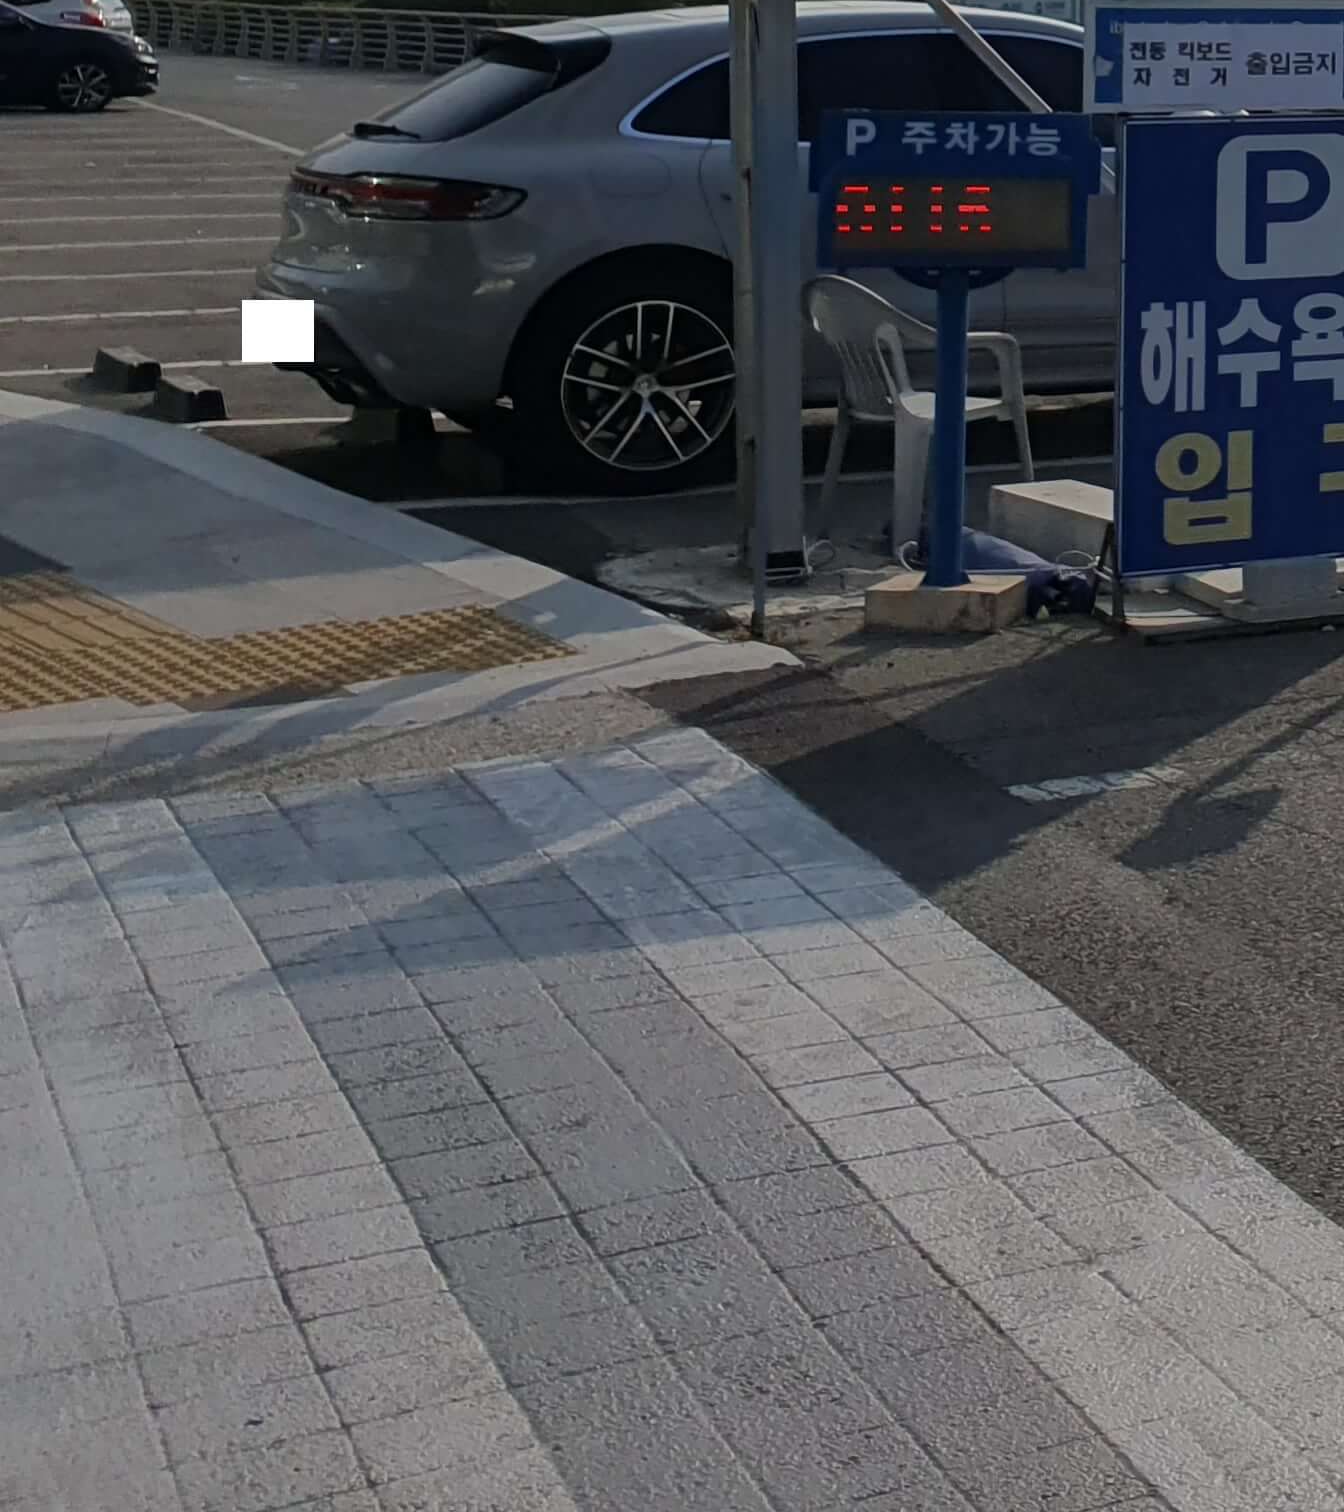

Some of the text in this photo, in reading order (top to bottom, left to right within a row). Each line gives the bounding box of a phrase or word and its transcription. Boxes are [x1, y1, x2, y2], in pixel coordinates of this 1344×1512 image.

[1129, 41, 1233, 61] 전동 킥보드
[1246, 51, 1337, 76] 출입금지
[846, 118, 1062, 157] P 주차가능
[1245, 149, 1332, 266] P
